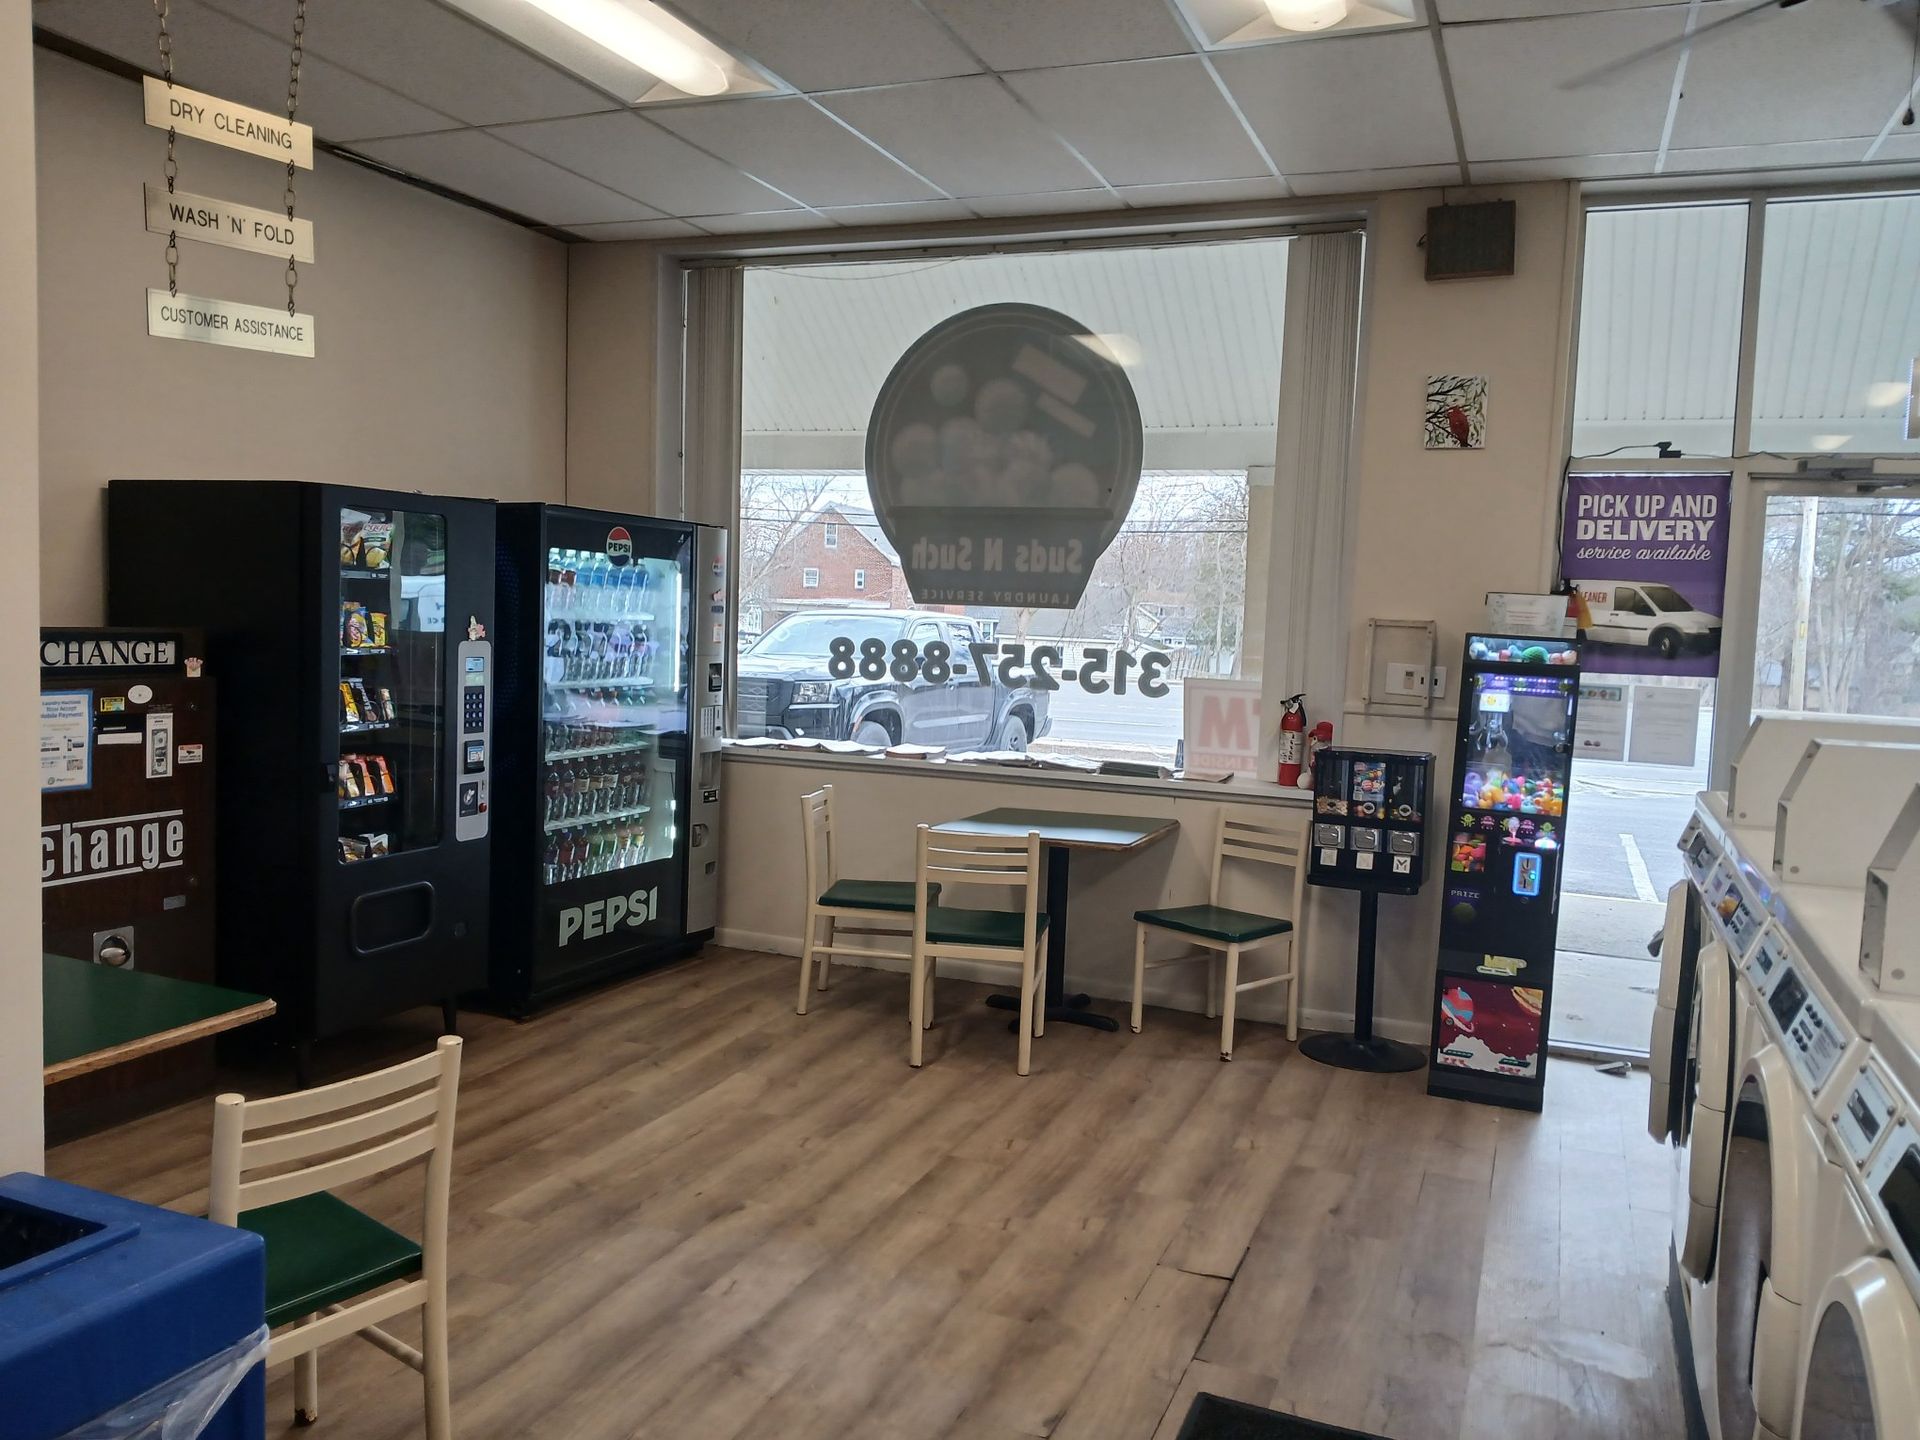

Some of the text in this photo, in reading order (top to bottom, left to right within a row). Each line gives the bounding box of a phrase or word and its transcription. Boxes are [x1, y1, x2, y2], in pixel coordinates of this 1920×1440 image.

[170, 98, 293, 150] DRY CLEANING
[169, 203, 220, 230] WASH
[254, 222, 295, 246] FOLD
[160, 305, 304, 342] CUSTOMER ASSISTANCE
[1578, 495, 1718, 518] PICK UP AND
[1576, 519, 1715, 541] DELIVERY
[608, 542, 631, 553] PEPSI
[1576, 543, 1712, 561] service available
[39, 639, 169, 666] CHANGE
[40, 818, 184, 879] change
[1450, 888, 1480, 899] PRIZE
[559, 886, 657, 947] PEPSI
